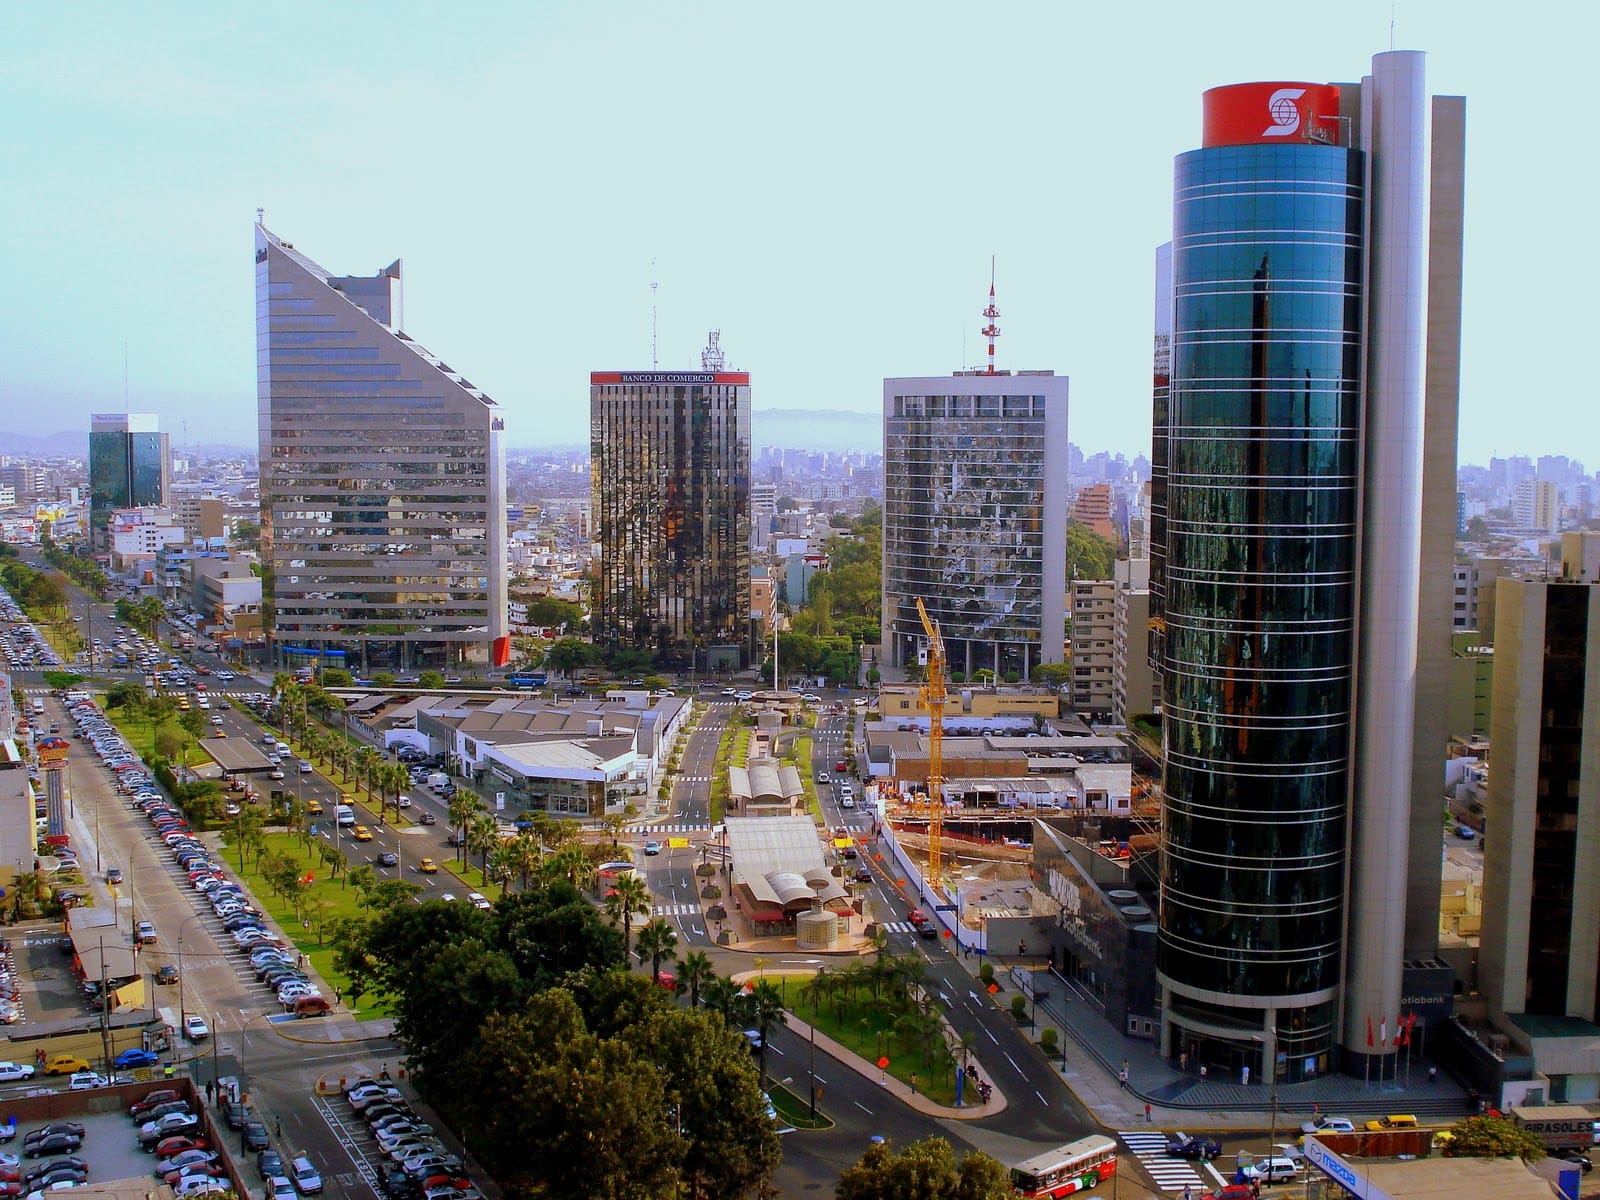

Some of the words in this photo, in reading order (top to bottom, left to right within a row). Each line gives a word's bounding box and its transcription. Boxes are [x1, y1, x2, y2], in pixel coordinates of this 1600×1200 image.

[622, 374, 652, 382] BANCO
[654, 374, 666, 382] DE
[667, 374, 714, 382] COMERCIO
[1524, 1121, 1593, 1133] GIRASOLES
